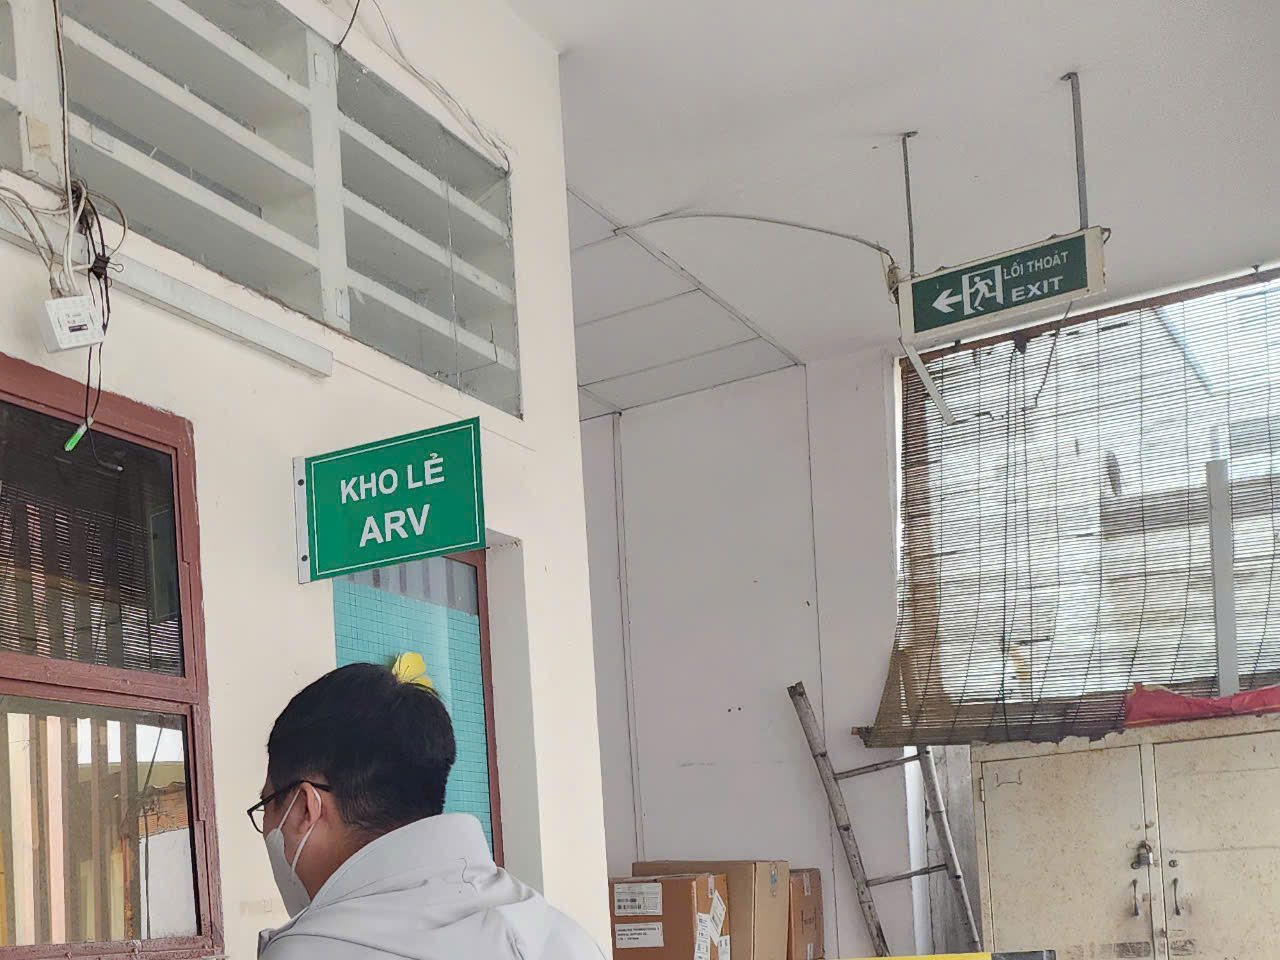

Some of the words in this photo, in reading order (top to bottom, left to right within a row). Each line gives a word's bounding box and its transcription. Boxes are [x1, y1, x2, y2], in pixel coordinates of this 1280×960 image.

[1003, 260, 1024, 280] LỐI
[1026, 251, 1069, 273] THOÁT
[1011, 275, 1063, 302] EXIT
[340, 468, 398, 505] KHO
[407, 452, 445, 489] LẺ
[359, 503, 430, 548] ARV
